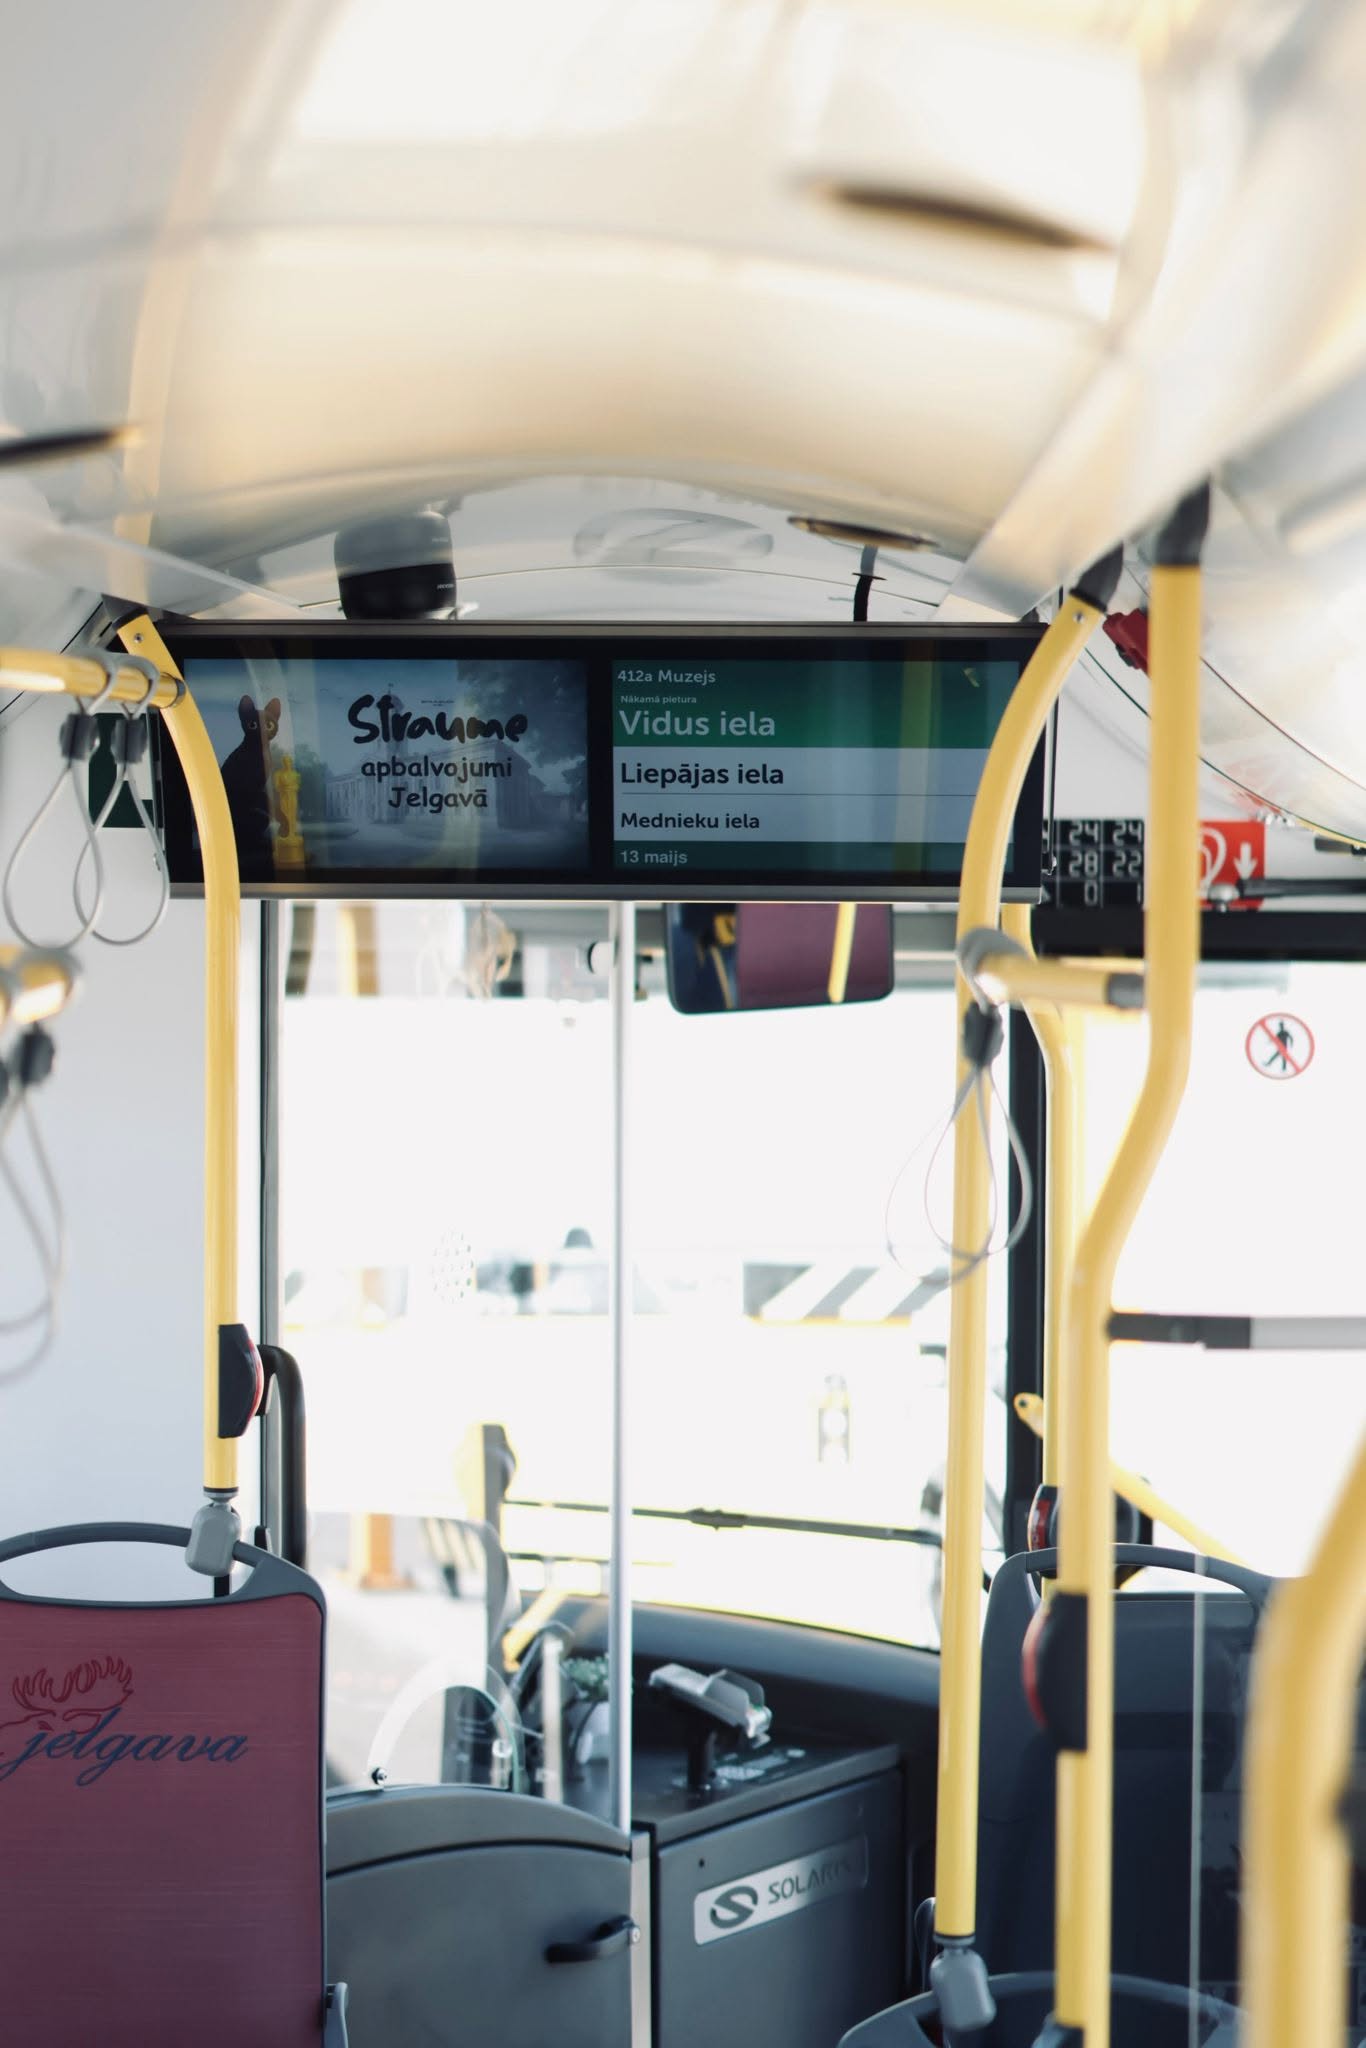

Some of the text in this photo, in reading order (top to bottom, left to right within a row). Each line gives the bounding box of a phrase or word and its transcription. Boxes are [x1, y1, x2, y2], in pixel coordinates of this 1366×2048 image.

[617, 669, 716, 686] 412a Muzejs
[662, 695, 697, 704] pietura
[347, 694, 528, 744] Straume
[619, 710, 776, 736] Vidus iela
[361, 755, 512, 783] apbalvojumi
[620, 763, 784, 788] Liepājas iela
[388, 787, 488, 814] Jelgavā
[620, 812, 760, 829] Mednieku iela
[620, 850, 688, 867] 13 maijs
[1068, 849, 1142, 878] 28 22
[0, 1706, 248, 1787] jelgava
